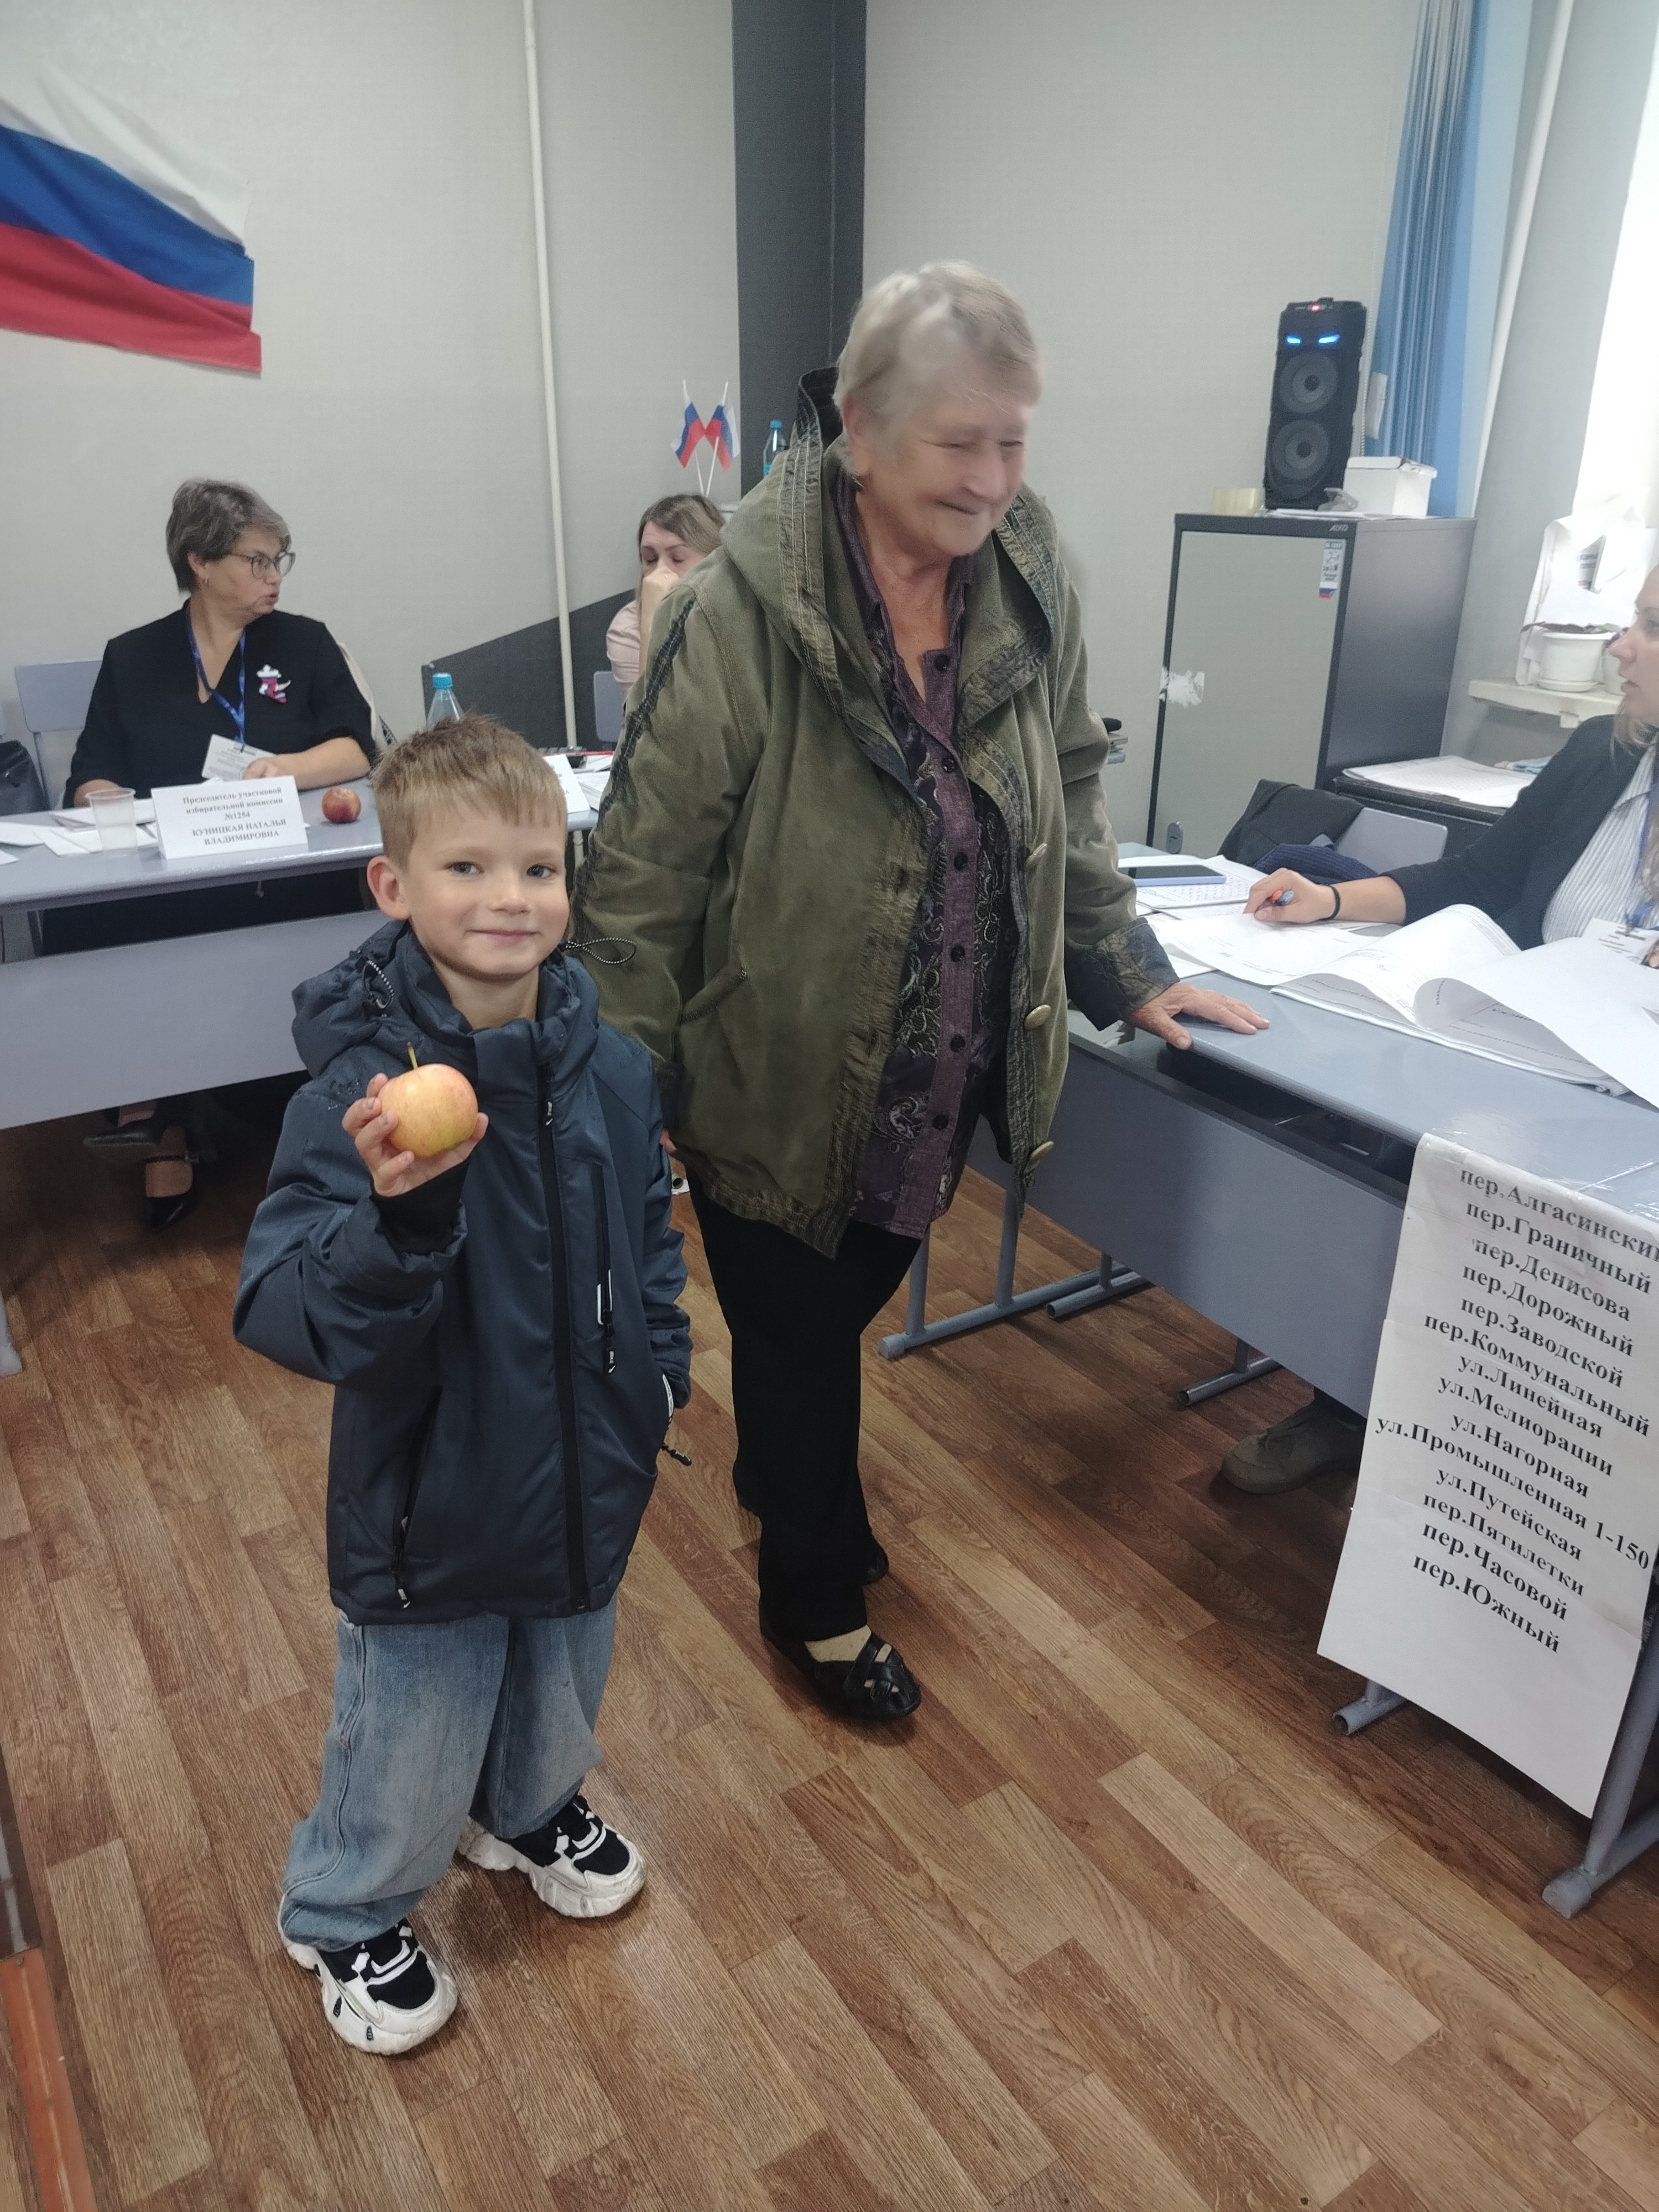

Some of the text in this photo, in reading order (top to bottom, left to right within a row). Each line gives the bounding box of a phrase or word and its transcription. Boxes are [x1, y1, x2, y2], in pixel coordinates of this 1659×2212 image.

[183, 787, 282, 805] Председатель участковой
[186, 799, 283, 815] избирательной комиссии
[193, 819, 286, 837] КУНИЦКАЯ НАТАЛЬЯ
[205, 831, 279, 845] ВЛАДИМИРОВНА
[1467, 1202, 1652, 1294] пер.Граничный
[1474, 1239, 1630, 1322] пер.Денисова
[1460, 1298, 1624, 1388] пер.Заводской
[1463, 1266, 1634, 1358] пер.Дорожный
[1424, 1315, 1650, 1437] пер.Коммунальный
[1458, 1355, 1604, 1438] ул.Линейная
[1438, 1376, 1614, 1477] ул.Мелиорации
[1451, 1415, 1589, 1498] ул.Нагорная
[1375, 1417, 1650, 1569] ул.Промышленная 1-150
[1436, 1469, 1582, 1561] ул.Путейская
[1422, 1523, 1567, 1621] пер.Часовой
[1423, 1494, 1584, 1597] пер.Пятилетки
[1412, 1555, 1561, 1653] пер.Южный
